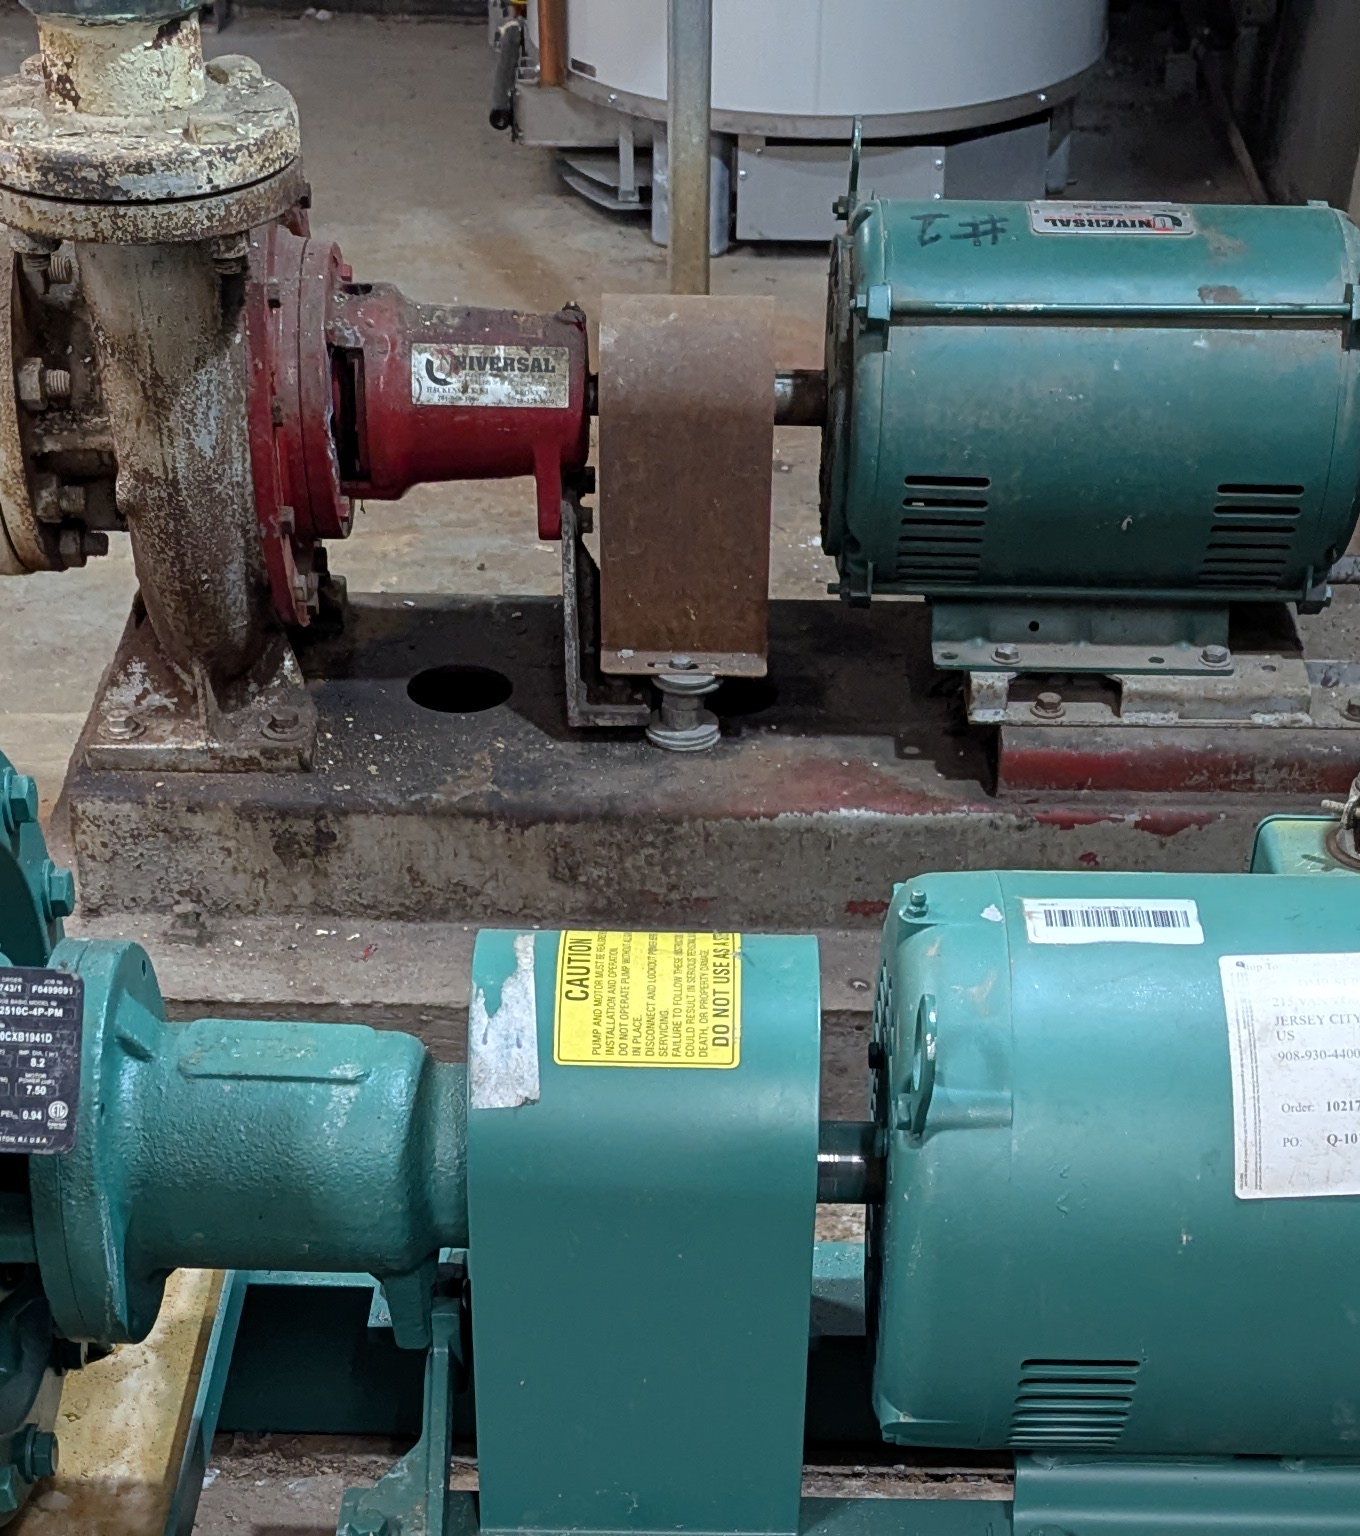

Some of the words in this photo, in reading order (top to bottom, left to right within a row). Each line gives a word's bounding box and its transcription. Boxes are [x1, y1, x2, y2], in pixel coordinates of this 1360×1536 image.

[1043, 212, 1184, 231] UNIVERSAL
[713, 949, 730, 959] AS
[565, 938, 592, 1001] CAUTION
[595, 961, 605, 978] MUST
[620, 966, 630, 984] PUMP
[674, 958, 683, 974] THESE
[687, 958, 697, 983] SERIOUS
[713, 962, 730, 983] USE
[594, 979, 604, 1006] MOTOR
[607, 980, 616, 994] AND
[647, 985, 656, 1000] AND
[673, 976, 683, 1005] FOLLOW
[699, 973, 710, 1009] PROPERTY
[619, 986, 630, 1020] OPERATE
[686, 995, 695, 1024] RESULT
[712, 989, 730, 1018] NOT
[593, 1011, 602, 1028] AND
[673, 1008, 682, 1018] TO
[699, 1012, 708, 1024] OR
[1275, 1015, 1325, 1026] JERSEY
[606, 995, 616, 1055] INSTALLATION
[619, 1023, 628, 1039] NOT
[632, 1015, 642, 1044] PLACE.
[645, 1002, 656, 1056] DISCONNECT
[658, 1008, 669, 1057] SERVICING.
[592, 1029, 601, 1055] PUMP
[672, 1020, 682, 1057] FAILURE
[685, 1027, 695, 1057] COULD
[699, 1026, 710, 1057] DEATH,
[712, 1024, 730, 1047] DO
[1276, 1031, 1295, 1042] US
[619, 1043, 628, 1056] DO
[632, 1046, 641, 1056] IN
[30, 1057, 46, 1068] 8.2
[26, 1085, 47, 1096] 7.50
[22, 1110, 43, 1121] 0.94
[1281, 1103, 1316, 1114] Order:
[1282, 1137, 1303, 1148] PO:
